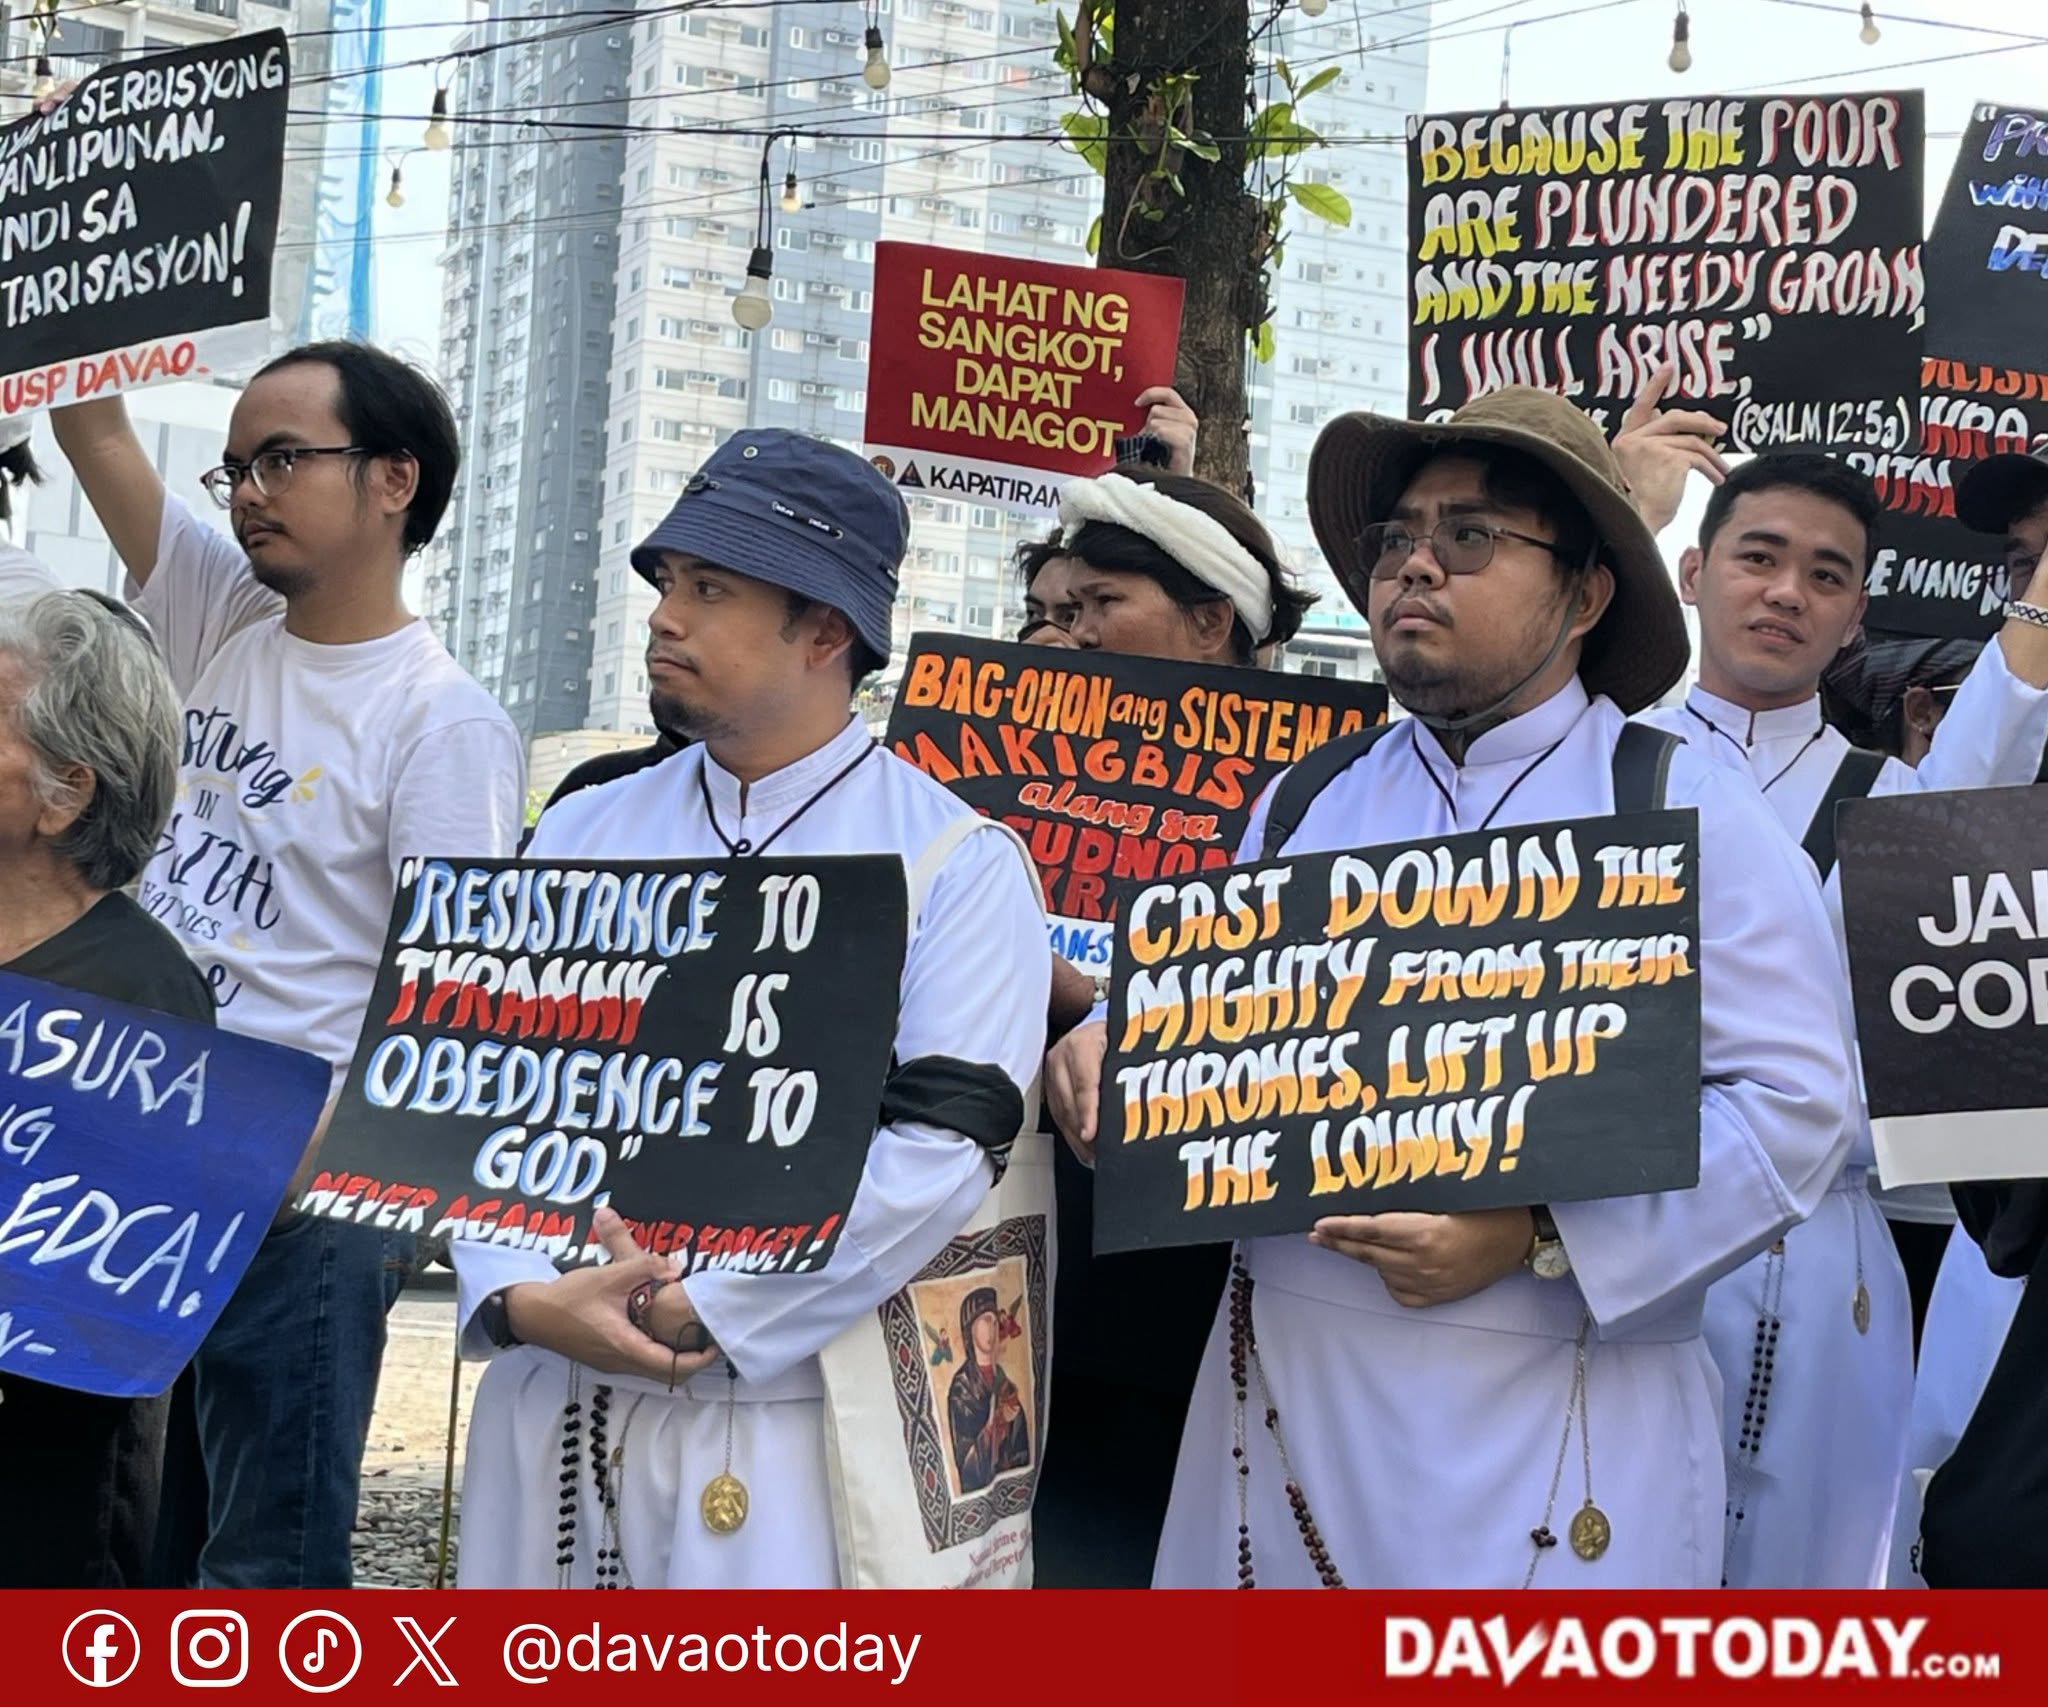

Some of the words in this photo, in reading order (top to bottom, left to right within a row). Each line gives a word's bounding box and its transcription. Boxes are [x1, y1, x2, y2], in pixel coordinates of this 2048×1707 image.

[76, 46, 285, 125] SERBISYONG
[0, 109, 225, 203] ANLIPUNAN,
[1406, 102, 1650, 187] "BECAUSE
[1660, 100, 1745, 171] THE
[1757, 97, 1902, 170] POOR
[0, 200, 70, 262] NDI
[78, 182, 138, 243] SA
[1418, 184, 1522, 260] ARE
[1534, 174, 1858, 249] PLUNDERED
[0, 201, 252, 328] TARISASYON!
[921, 268, 1057, 322] LAHAT
[1062, 289, 1130, 333] NG
[1413, 258, 1511, 325] AND
[1511, 257, 1599, 318] THE
[1604, 249, 1765, 318] NEEDY
[1767, 244, 1925, 334] GROAN,
[0, 364, 67, 415] USP
[917, 311, 1124, 382] SANGKOT,
[955, 358, 1083, 409] DAPAT
[1420, 332, 1440, 406] I
[1458, 325, 1585, 404] WILL
[911, 392, 1125, 457] MANAGOT
[1732, 397, 1822, 453] (PSALM
[905, 653, 1113, 740] BAG-OHON
[1108, 691, 1168, 742] ang
[194, 789, 221, 820] IN
[894, 721, 1263, 811] MAKIGBIS
[1018, 780, 1154, 836] alang
[1156, 808, 1222, 842] sa
[398, 856, 727, 957] "RESISTANCE
[753, 873, 821, 953] TO
[1128, 864, 1293, 965] CAST
[1322, 828, 1580, 938] DOWN
[1594, 842, 1687, 909] THE
[386, 947, 668, 1045] TYRANNY
[723, 972, 790, 1057] IS
[1118, 937, 1379, 1052] MIGHTY
[1379, 939, 1544, 1006] FROM
[1553, 933, 1695, 993] THEIR
[0, 999, 211, 1126] ASURA
[363, 1034, 727, 1137] OBEDIENCE
[746, 1067, 818, 1148] TO
[1116, 1031, 1377, 1144] THRONES,
[1386, 1014, 1516, 1099] LIFT
[1524, 1002, 1628, 1083] UP
[1178, 1128, 1283, 1211] THE
[1308, 1084, 1538, 1197] LOWLY!
[0, 1173, 246, 1318] EDCA!
[298, 1170, 438, 1232] NEVER
[431, 1196, 579, 1263] AGAIN,
